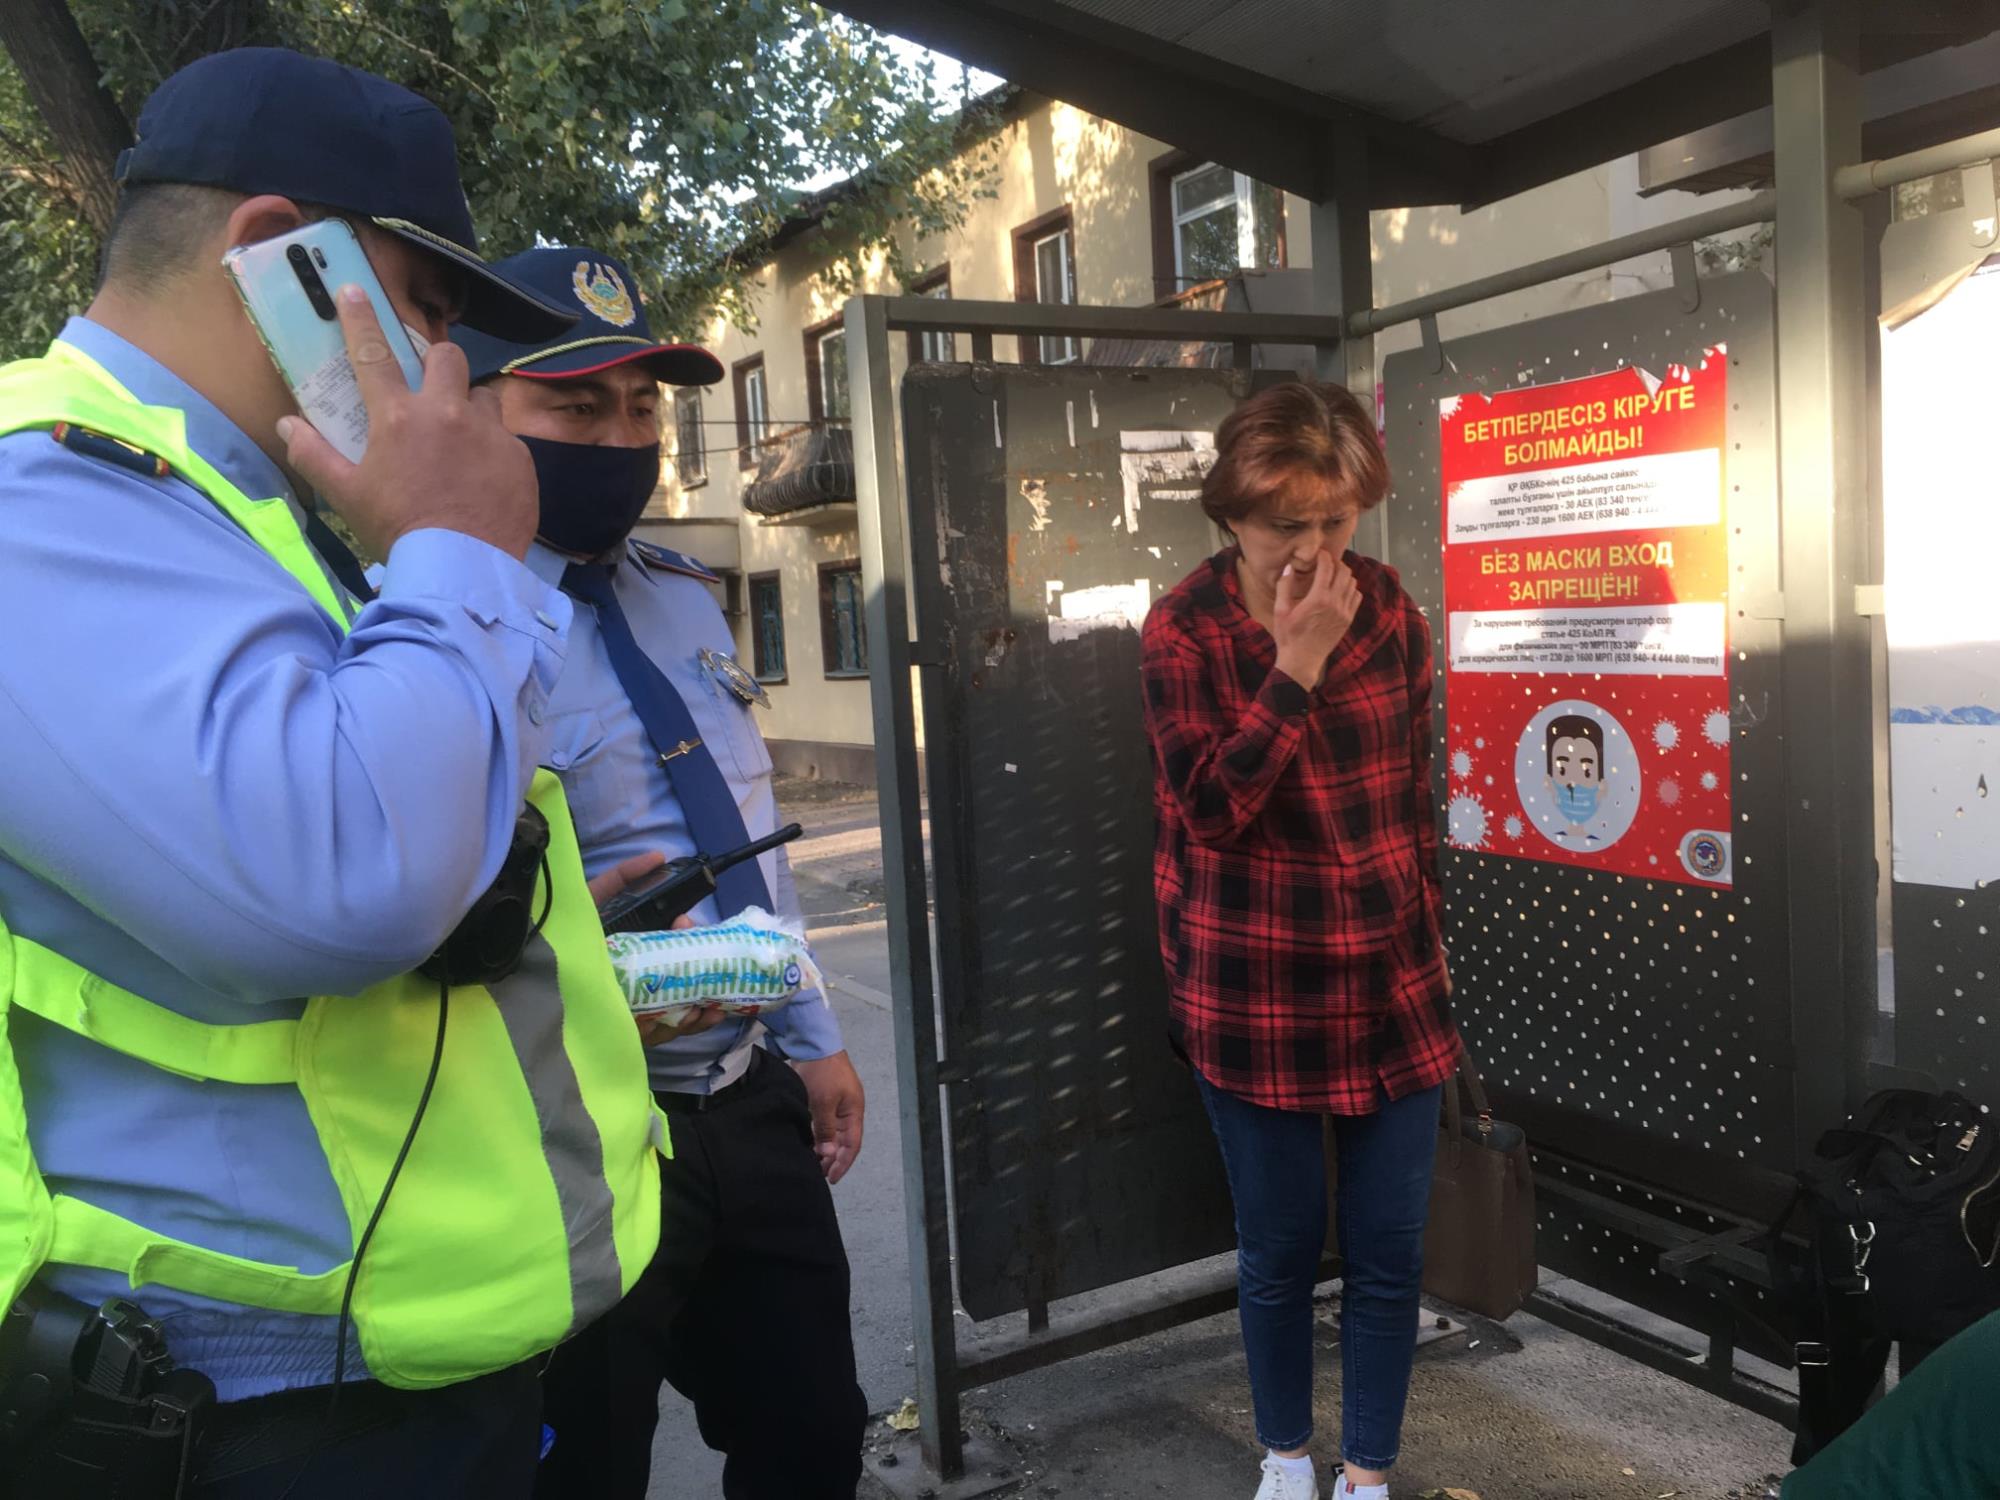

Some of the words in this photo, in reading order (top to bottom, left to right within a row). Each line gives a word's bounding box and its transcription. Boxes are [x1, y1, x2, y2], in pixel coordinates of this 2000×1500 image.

[1464, 401, 1606, 443] БЕТПЕРДЕСІЗ
[1614, 385, 1695, 419] КІРУГЕ
[1504, 426, 1643, 466] БОЛМАЙДЫ!
[1561, 475, 1575, 485] 425
[1576, 498, 1594, 508] АЕК
[1577, 510, 1594, 520] АЕК
[1480, 552, 1521, 575] БЕЗ
[1526, 547, 1602, 573] МАСКИ
[1608, 541, 1674, 569] ВХОД
[1509, 572, 1639, 601] ЗАПРЕЩЁН!
[1568, 629, 1581, 638] 425
[1605, 628, 1616, 638] РК
[1550, 652, 1562, 661] 230
[1595, 652, 1613, 661] МРП
